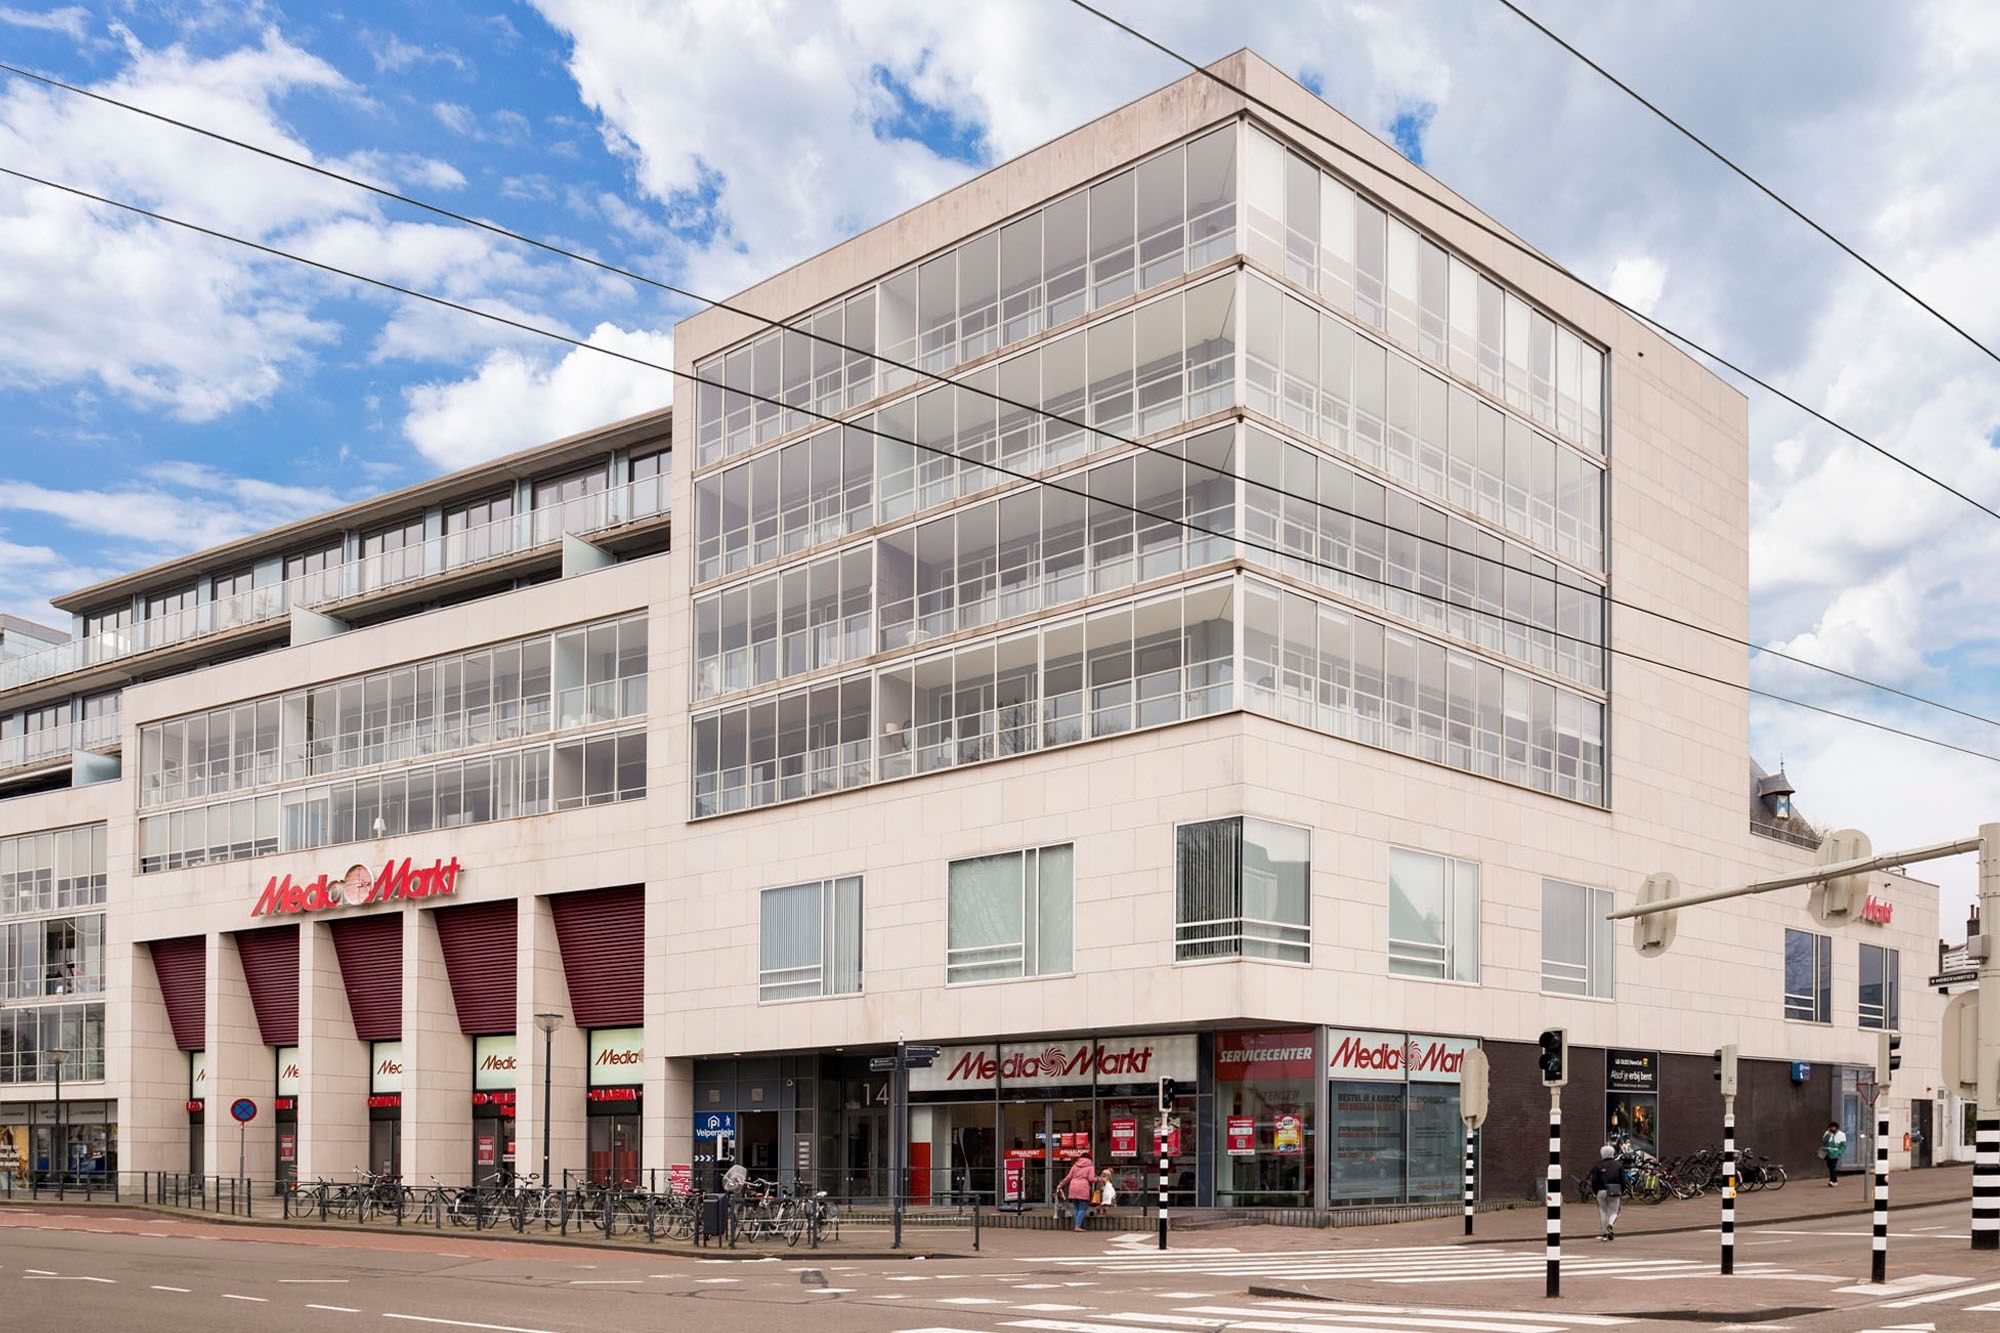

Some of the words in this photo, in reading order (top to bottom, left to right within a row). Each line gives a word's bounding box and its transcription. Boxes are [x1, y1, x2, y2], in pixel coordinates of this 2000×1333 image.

[251, 873, 342, 917] Media
[366, 856, 460, 903] Markt
[1861, 895, 1892, 923] Markt
[595, 1049, 638, 1066] Media
[947, 1051, 1041, 1081] Media
[1062, 1045, 1152, 1076] Markt
[1219, 1047, 1312, 1063] SERVICECENTER
[1330, 1037, 1401, 1071] Media
[1419, 1042, 1463, 1073] Mar
[591, 1088, 638, 1101] PLASMA
[863, 1083, 889, 1106] 14
[696, 1128, 734, 1138] Velperplein
